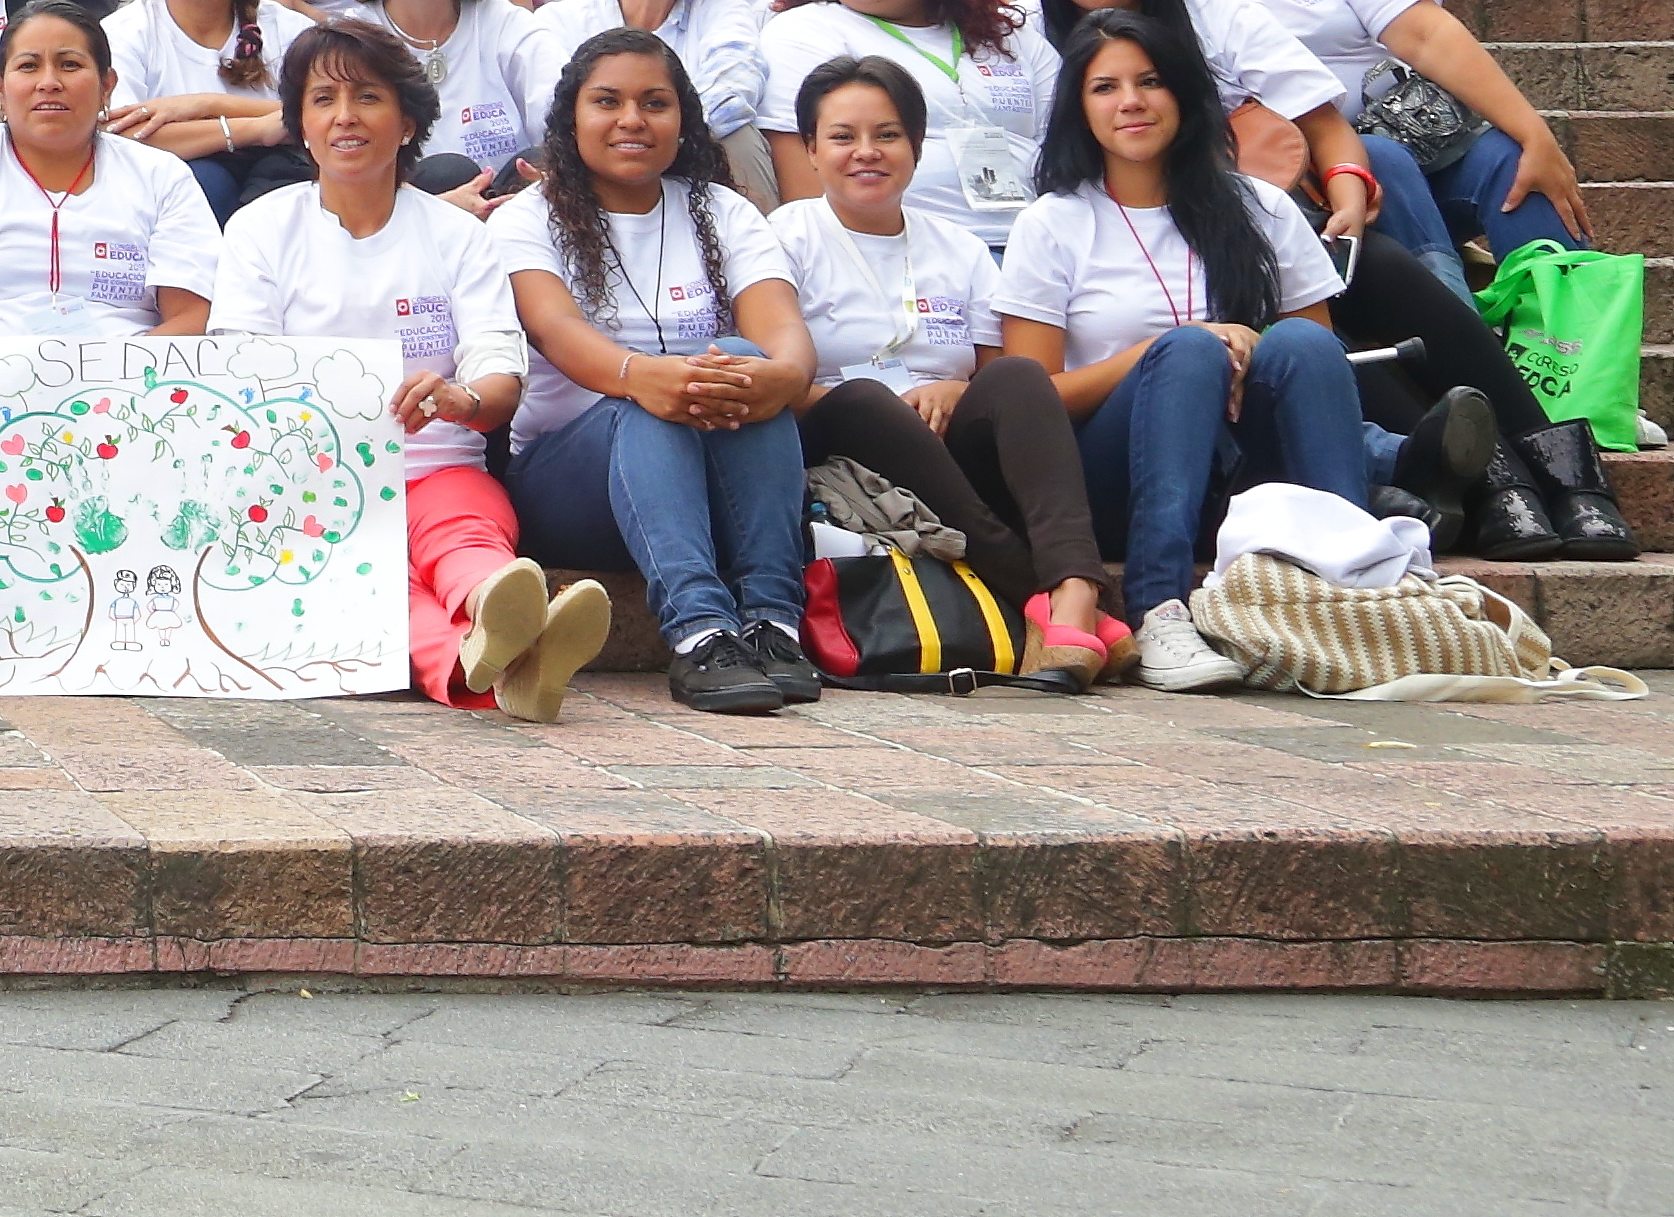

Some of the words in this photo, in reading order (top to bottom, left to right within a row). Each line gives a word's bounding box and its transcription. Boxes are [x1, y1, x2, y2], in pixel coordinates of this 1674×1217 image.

[472, 108, 507, 121] EDUCA
[491, 118, 511, 127] 2015
[687, 284, 714, 299] EDU
[412, 303, 445, 315] EDUC
[678, 322, 716, 334] PUEN
[35, 339, 227, 387] SEDAC
